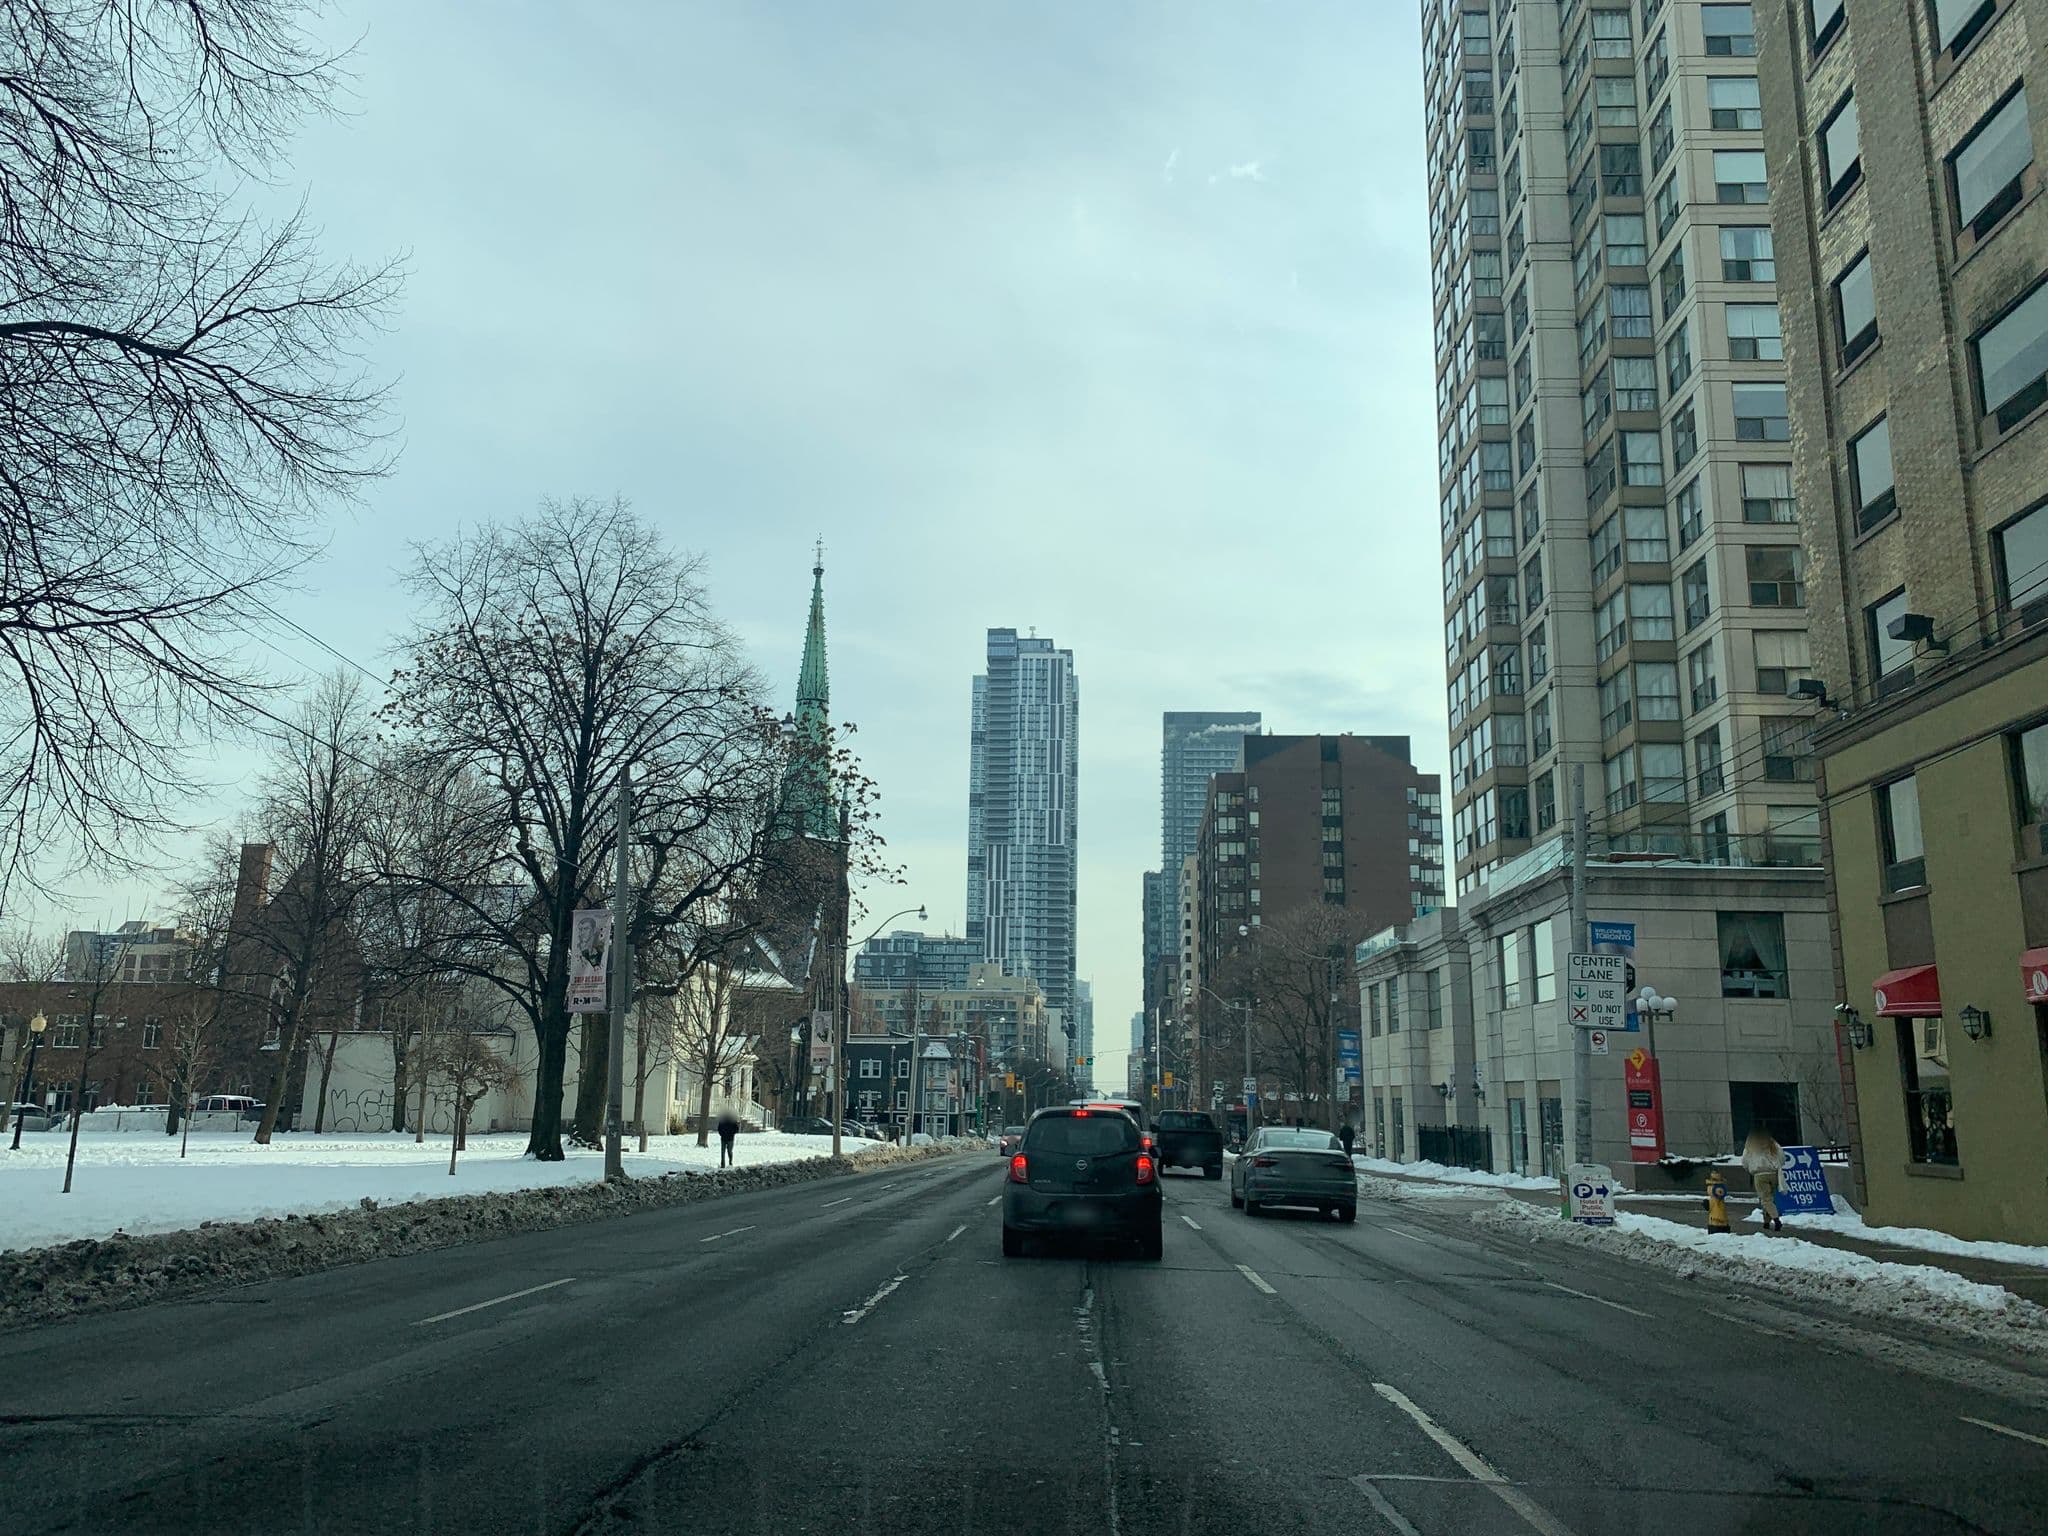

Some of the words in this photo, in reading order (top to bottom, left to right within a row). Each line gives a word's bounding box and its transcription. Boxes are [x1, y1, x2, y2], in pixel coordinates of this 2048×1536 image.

[1595, 933, 1631, 941] TORONTO
[1572, 956, 1621, 967] CENTRE
[1580, 969, 1614, 980] LANE
[1598, 990, 1614, 999] USE
[1591, 1004, 1602, 1013] DO
[1605, 1004, 1622, 1014] NOT
[1598, 1016, 1614, 1026] USE
[1782, 1169, 1820, 1181] ONTHLY
[1785, 1181, 1824, 1192] ARKING
